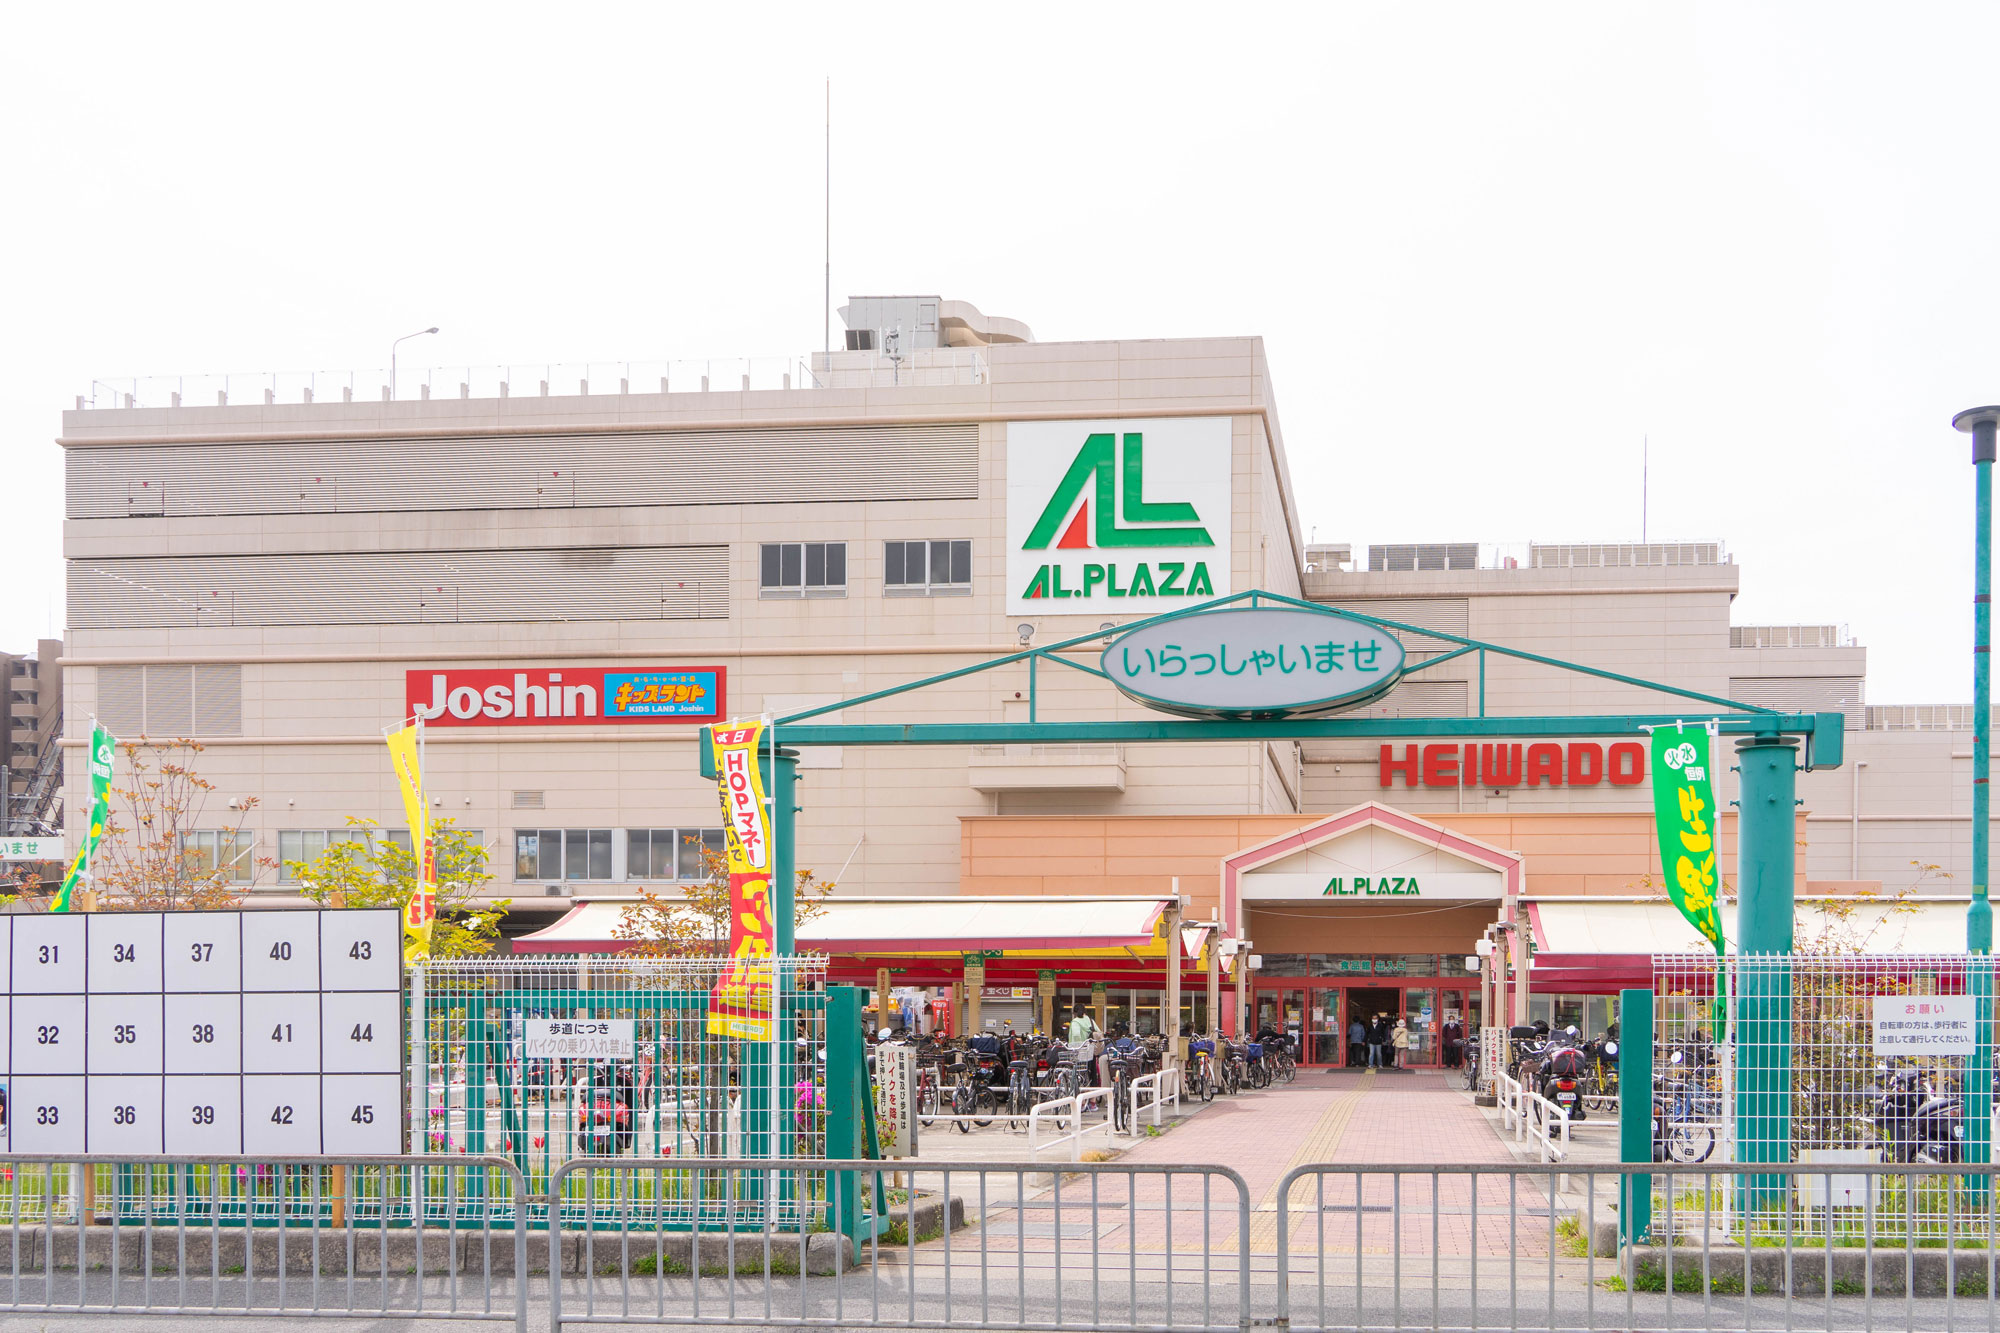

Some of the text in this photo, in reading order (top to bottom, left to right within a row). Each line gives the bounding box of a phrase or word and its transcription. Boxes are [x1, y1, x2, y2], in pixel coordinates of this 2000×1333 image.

[1021, 561, 1214, 599] AL.PLAZA
[1123, 640, 1382, 677] いらっしゃいませ
[413, 673, 597, 720] Joshin
[614, 682, 706, 711] キッズランド
[1380, 742, 1645, 787] HEIWADO
[1322, 877, 1420, 895] AL.PLAZA
[39, 946, 58, 964] 31
[114, 944, 135, 962] 34
[192, 943, 213, 961] 37
[270, 942, 292, 960] 40
[350, 941, 371, 960] 43
[1340, 960, 1406, 970] 食品館 出入口
[1905, 1004, 1945, 1014] お願い
[114, 1025, 135, 1043] 35
[193, 1025, 214, 1043] 38
[272, 1024, 293, 1042] 41
[351, 1024, 373, 1042] 44
[549, 1023, 609, 1034] 歩道につき
[1880, 1021, 1967, 1030] 自転車の方は、歩行者に
[38, 1026, 59, 1044] 32
[1879, 1035, 1971, 1044] 注意して通行してください。
[529, 1038, 631, 1055] バイクの乗り入れ禁止
[37, 1106, 58, 1125] 33
[114, 1106, 135, 1124] 36
[193, 1106, 214, 1124] 39
[271, 1106, 293, 1124] 42
[351, 1105, 373, 1124] 45
